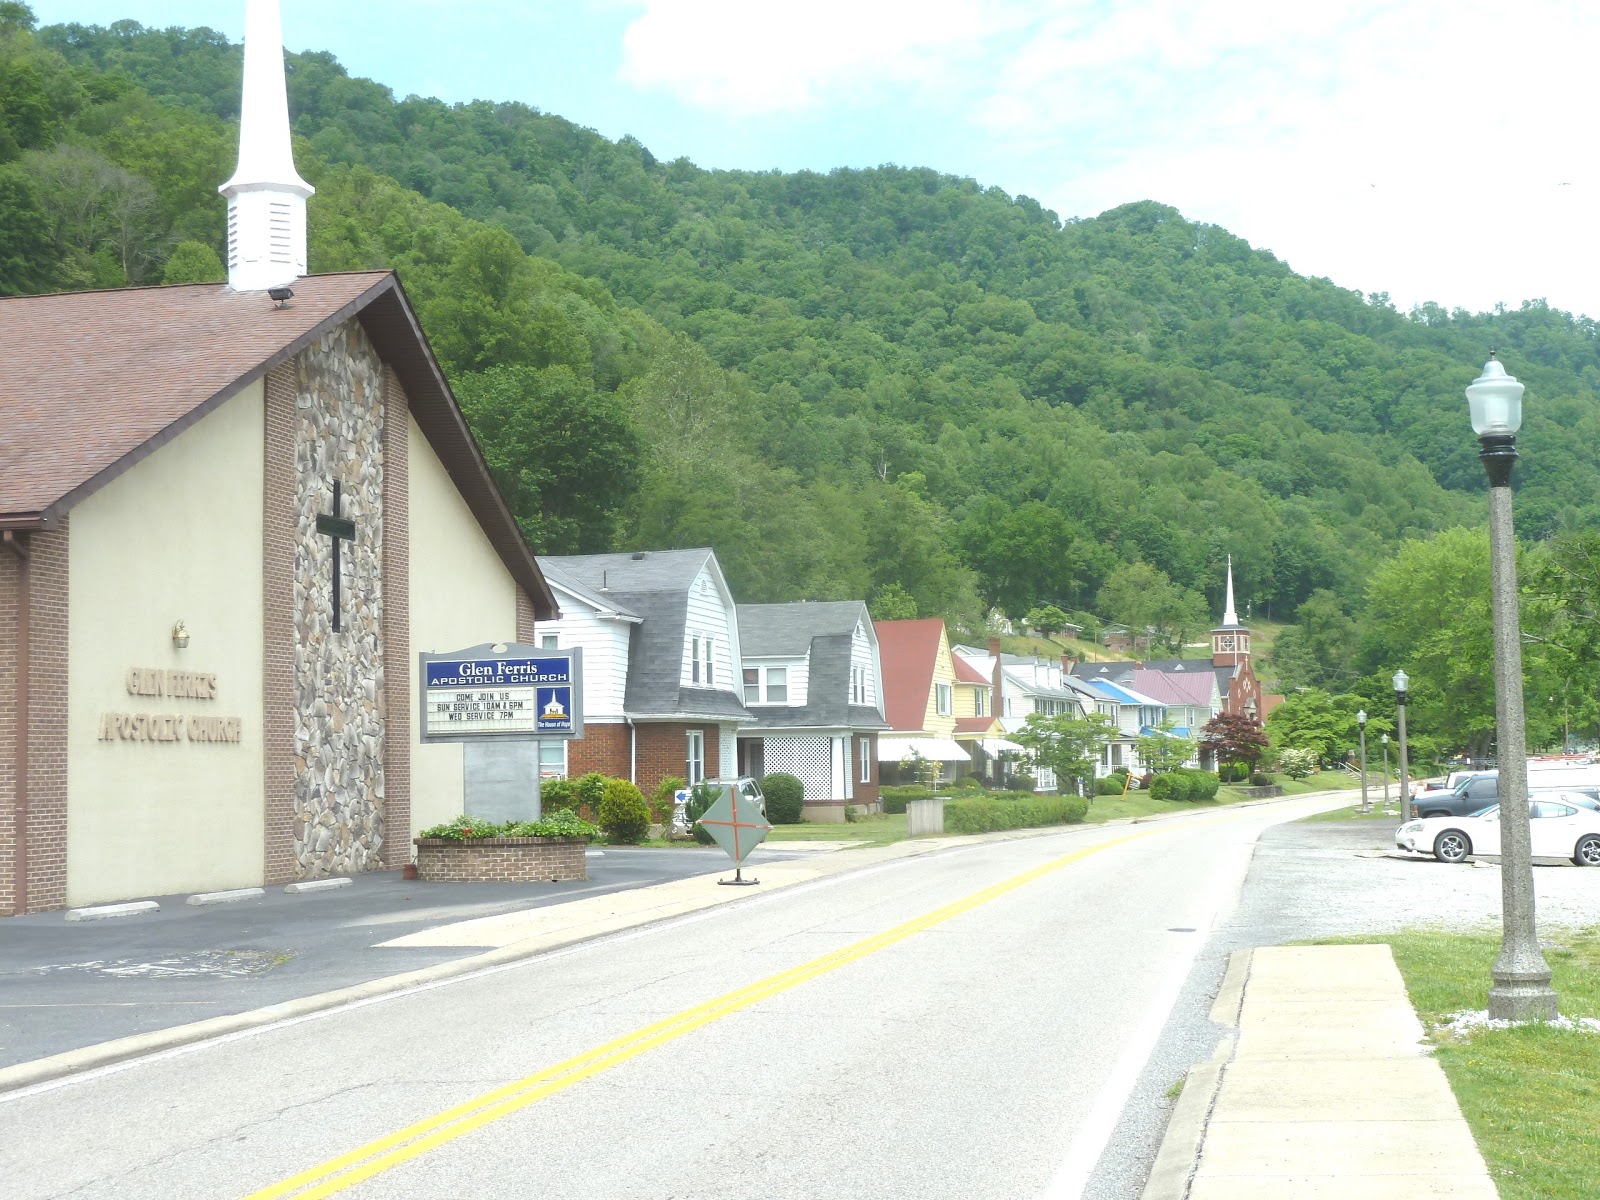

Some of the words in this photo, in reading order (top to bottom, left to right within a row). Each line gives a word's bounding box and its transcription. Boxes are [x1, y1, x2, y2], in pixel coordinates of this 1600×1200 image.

[459, 662, 493, 676] Glen
[497, 660, 538, 675] Ferris
[126, 667, 166, 696] GLEN
[167, 670, 217, 699] FERRIS
[431, 676, 505, 685] APOSTOLIC
[511, 673, 567, 682] CHURCH
[456, 693, 474, 702] COME
[478, 692, 494, 701] JOIN
[499, 692, 510, 701] US
[437, 703, 450, 712] SUN
[453, 703, 481, 711] SERVICE
[483, 702, 500, 710] 10AM
[508, 701, 523, 709] 6PM
[466, 712, 494, 720] SERVICE
[500, 711, 514, 719] 7PM
[98, 712, 184, 741] APOSTOLIC
[187, 714, 242, 743] CHURCH
